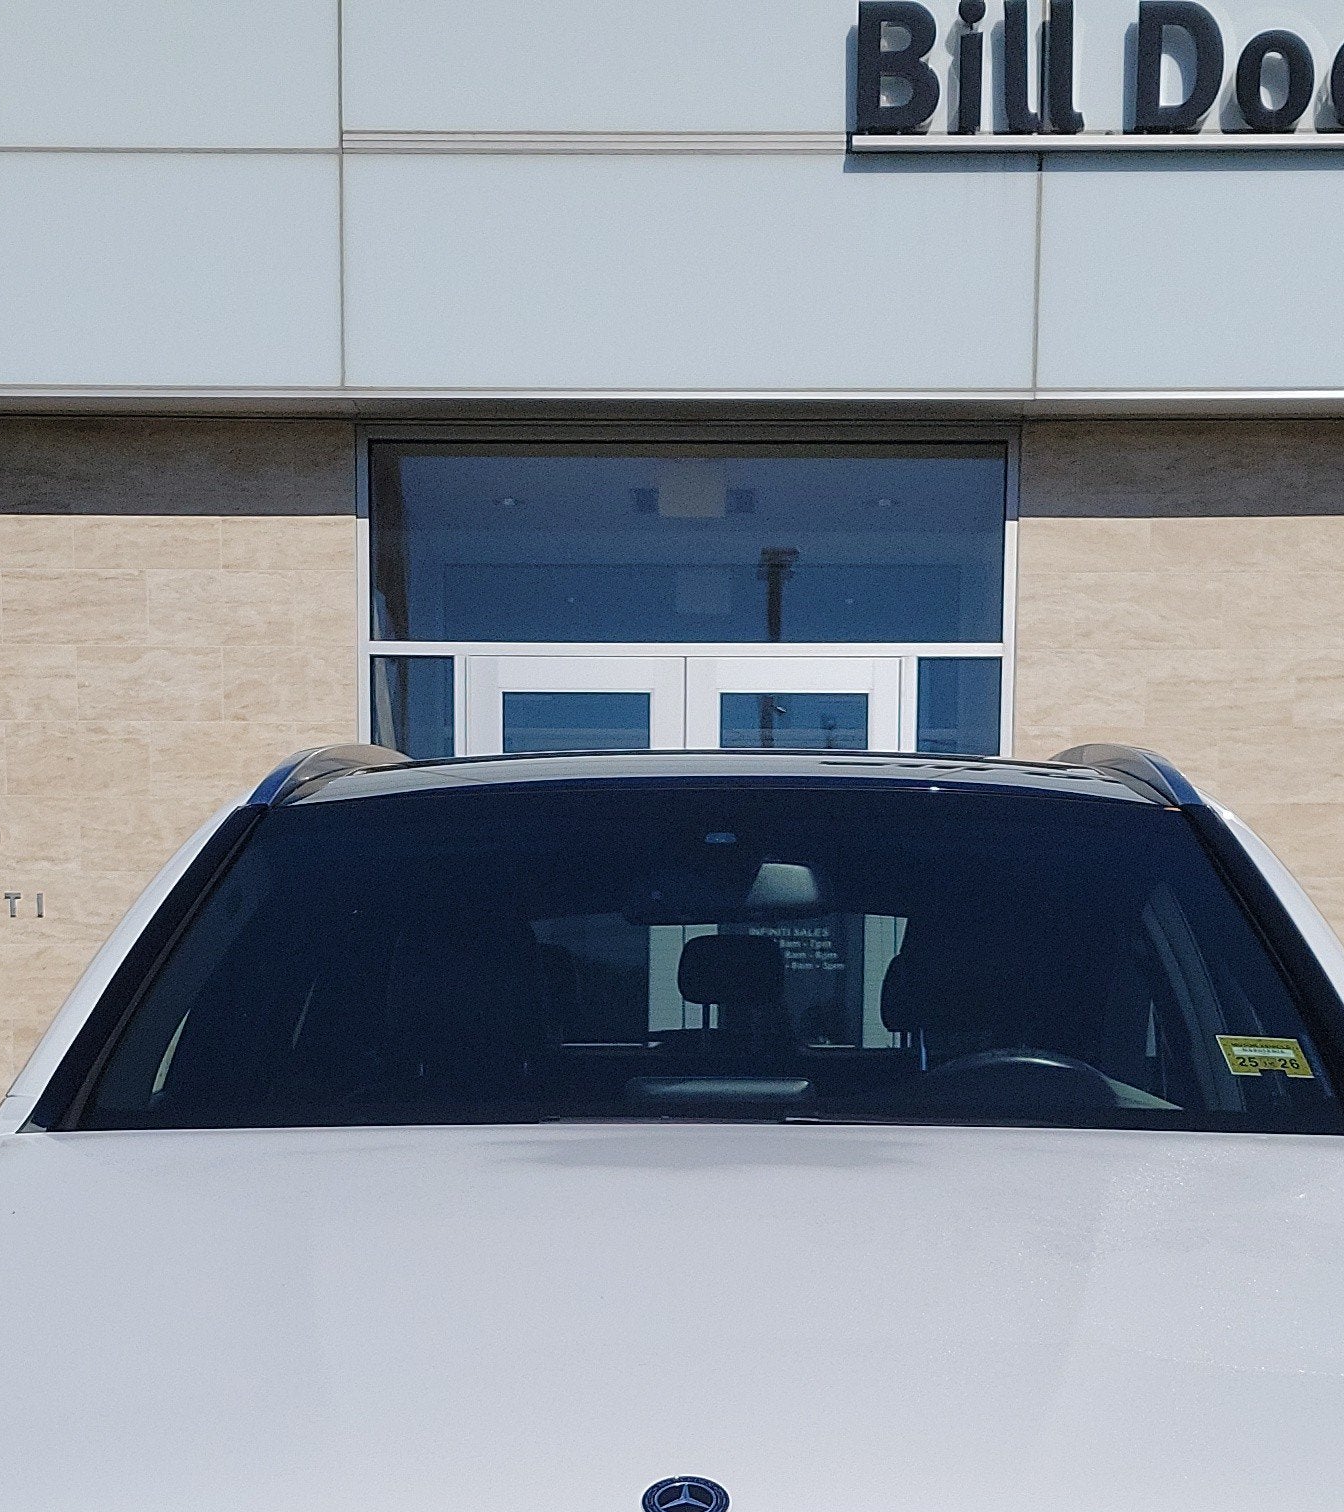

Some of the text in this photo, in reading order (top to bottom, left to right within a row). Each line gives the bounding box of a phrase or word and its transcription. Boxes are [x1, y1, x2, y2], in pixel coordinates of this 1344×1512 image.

[857, 0, 1084, 134] Bill
[793, 928, 829, 937] SALES
[1236, 1057, 1258, 1067] 25
[1278, 1059, 1299, 1069] 26
